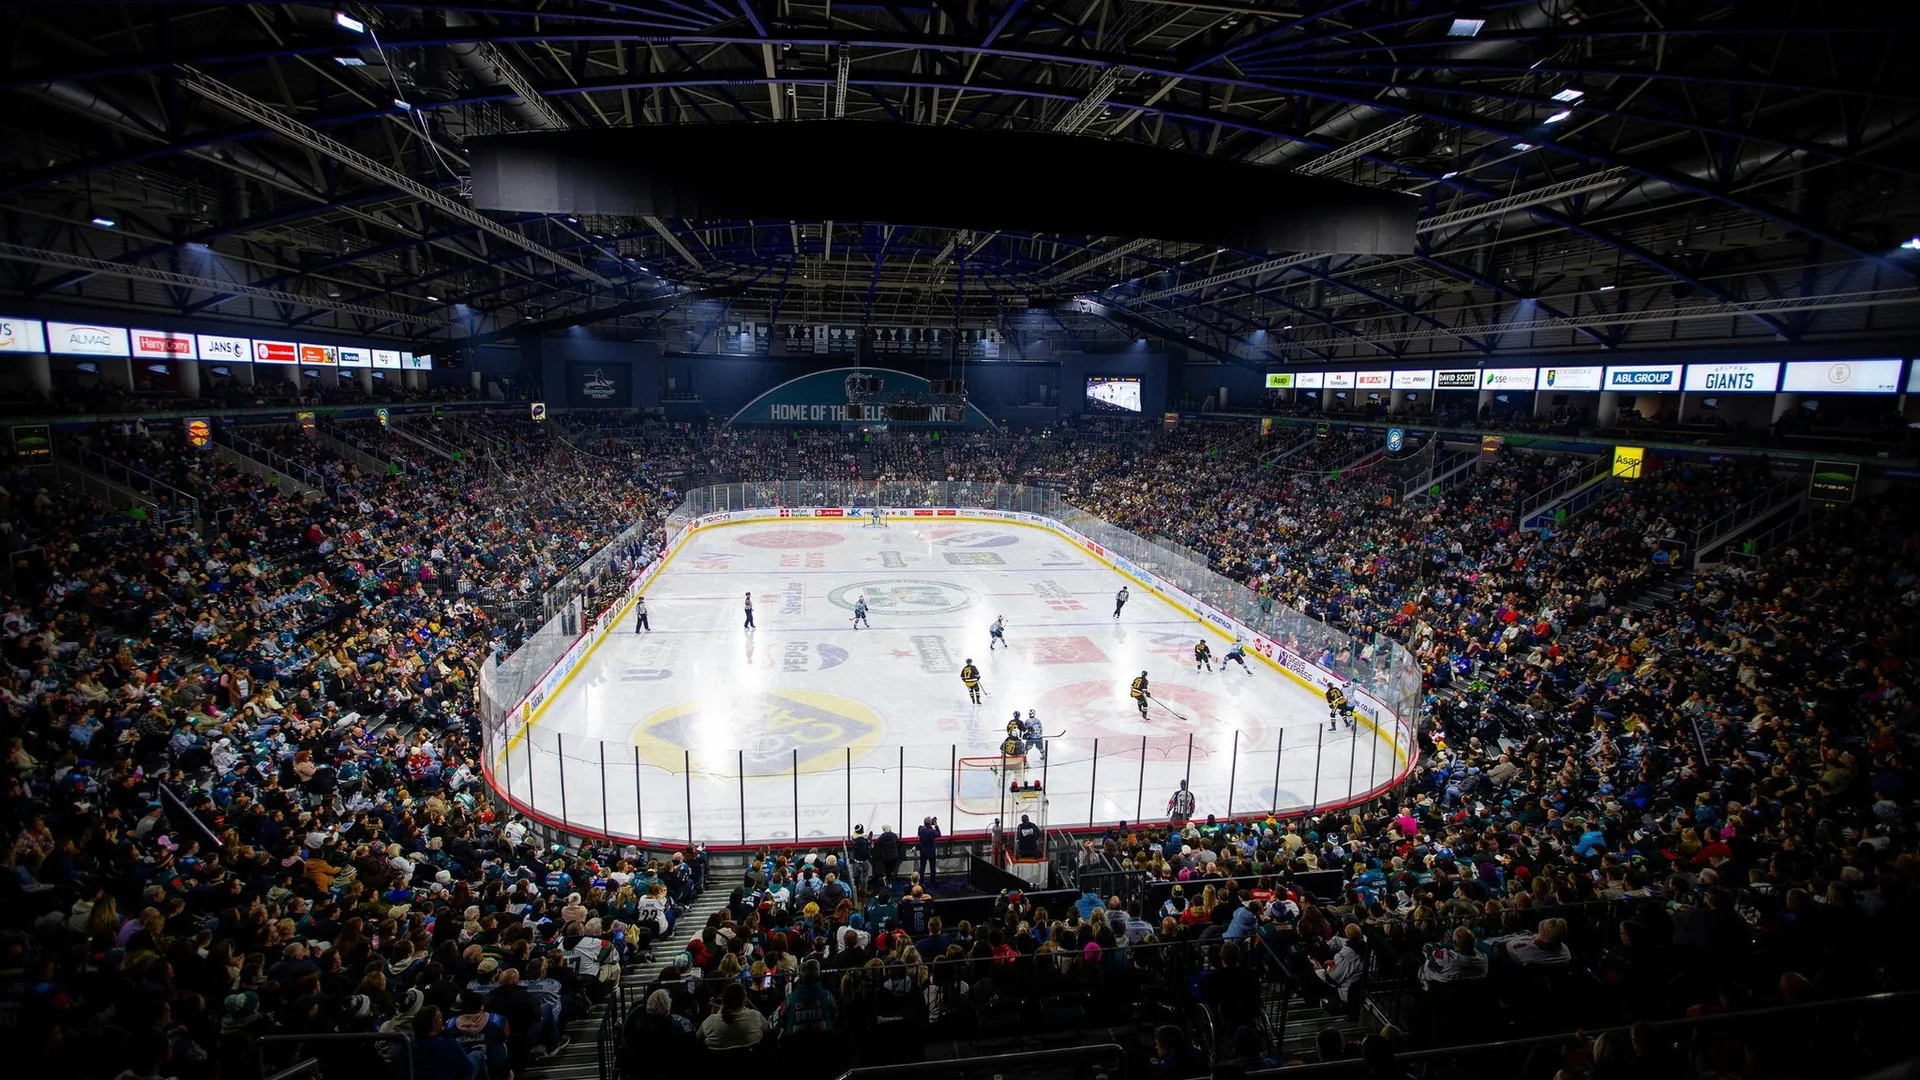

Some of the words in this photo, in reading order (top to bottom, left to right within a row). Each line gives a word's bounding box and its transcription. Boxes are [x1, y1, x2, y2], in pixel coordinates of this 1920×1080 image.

[69, 333, 111, 346] ALMAC
[140, 338, 165, 350] Harry
[165, 340, 188, 352] Corry
[209, 341, 232, 353] JANS
[1273, 376, 1287, 386] Asap
[1439, 374, 1455, 382] DAVID
[1494, 375, 1507, 384] sse
[1615, 373, 1633, 383] ABL
[1635, 372, 1669, 383] GROUP
[1705, 372, 1754, 389] GIANTS
[771, 404, 807, 420] HOME
[811, 405, 826, 421] OF
[1615, 454, 1640, 466] Asap
[783, 641, 809, 672] PEPSI
[1288, 654, 1306, 670] SIGNS
[1286, 661, 1313, 682] EXPRESS
[914, 911, 924, 931] 6
[795, 1009, 823, 1021] DWYER
